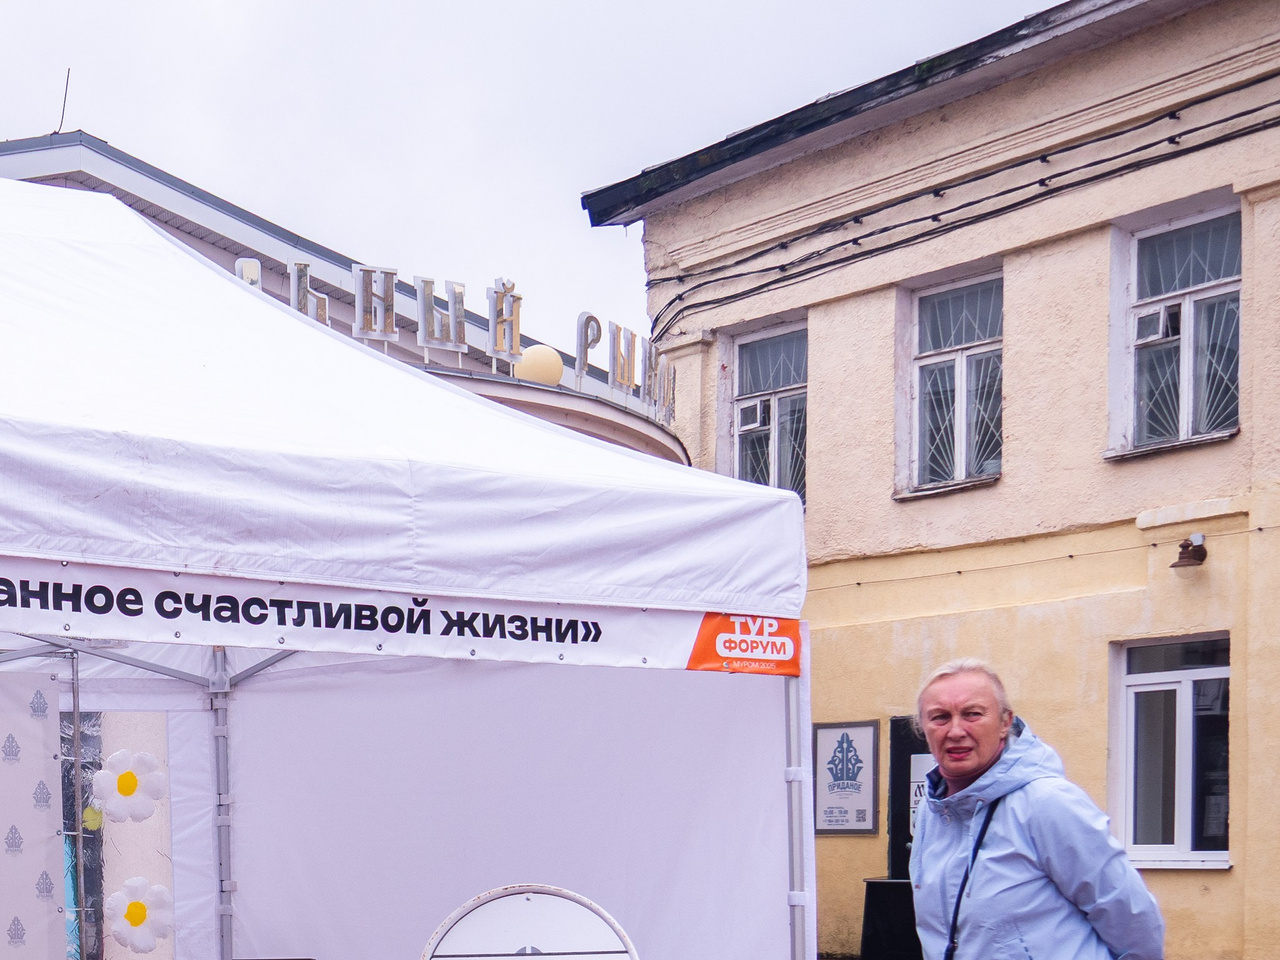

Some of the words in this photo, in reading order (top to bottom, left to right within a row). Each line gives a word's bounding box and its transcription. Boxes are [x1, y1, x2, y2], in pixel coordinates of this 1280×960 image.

[154, 589, 431, 635] счастливой
[441, 604, 603, 644] жизни»
[730, 616, 778, 636] ТУР
[723, 638, 786, 655] ФОРУМ
[828, 782, 862, 792] ПРИДАНОЕ
